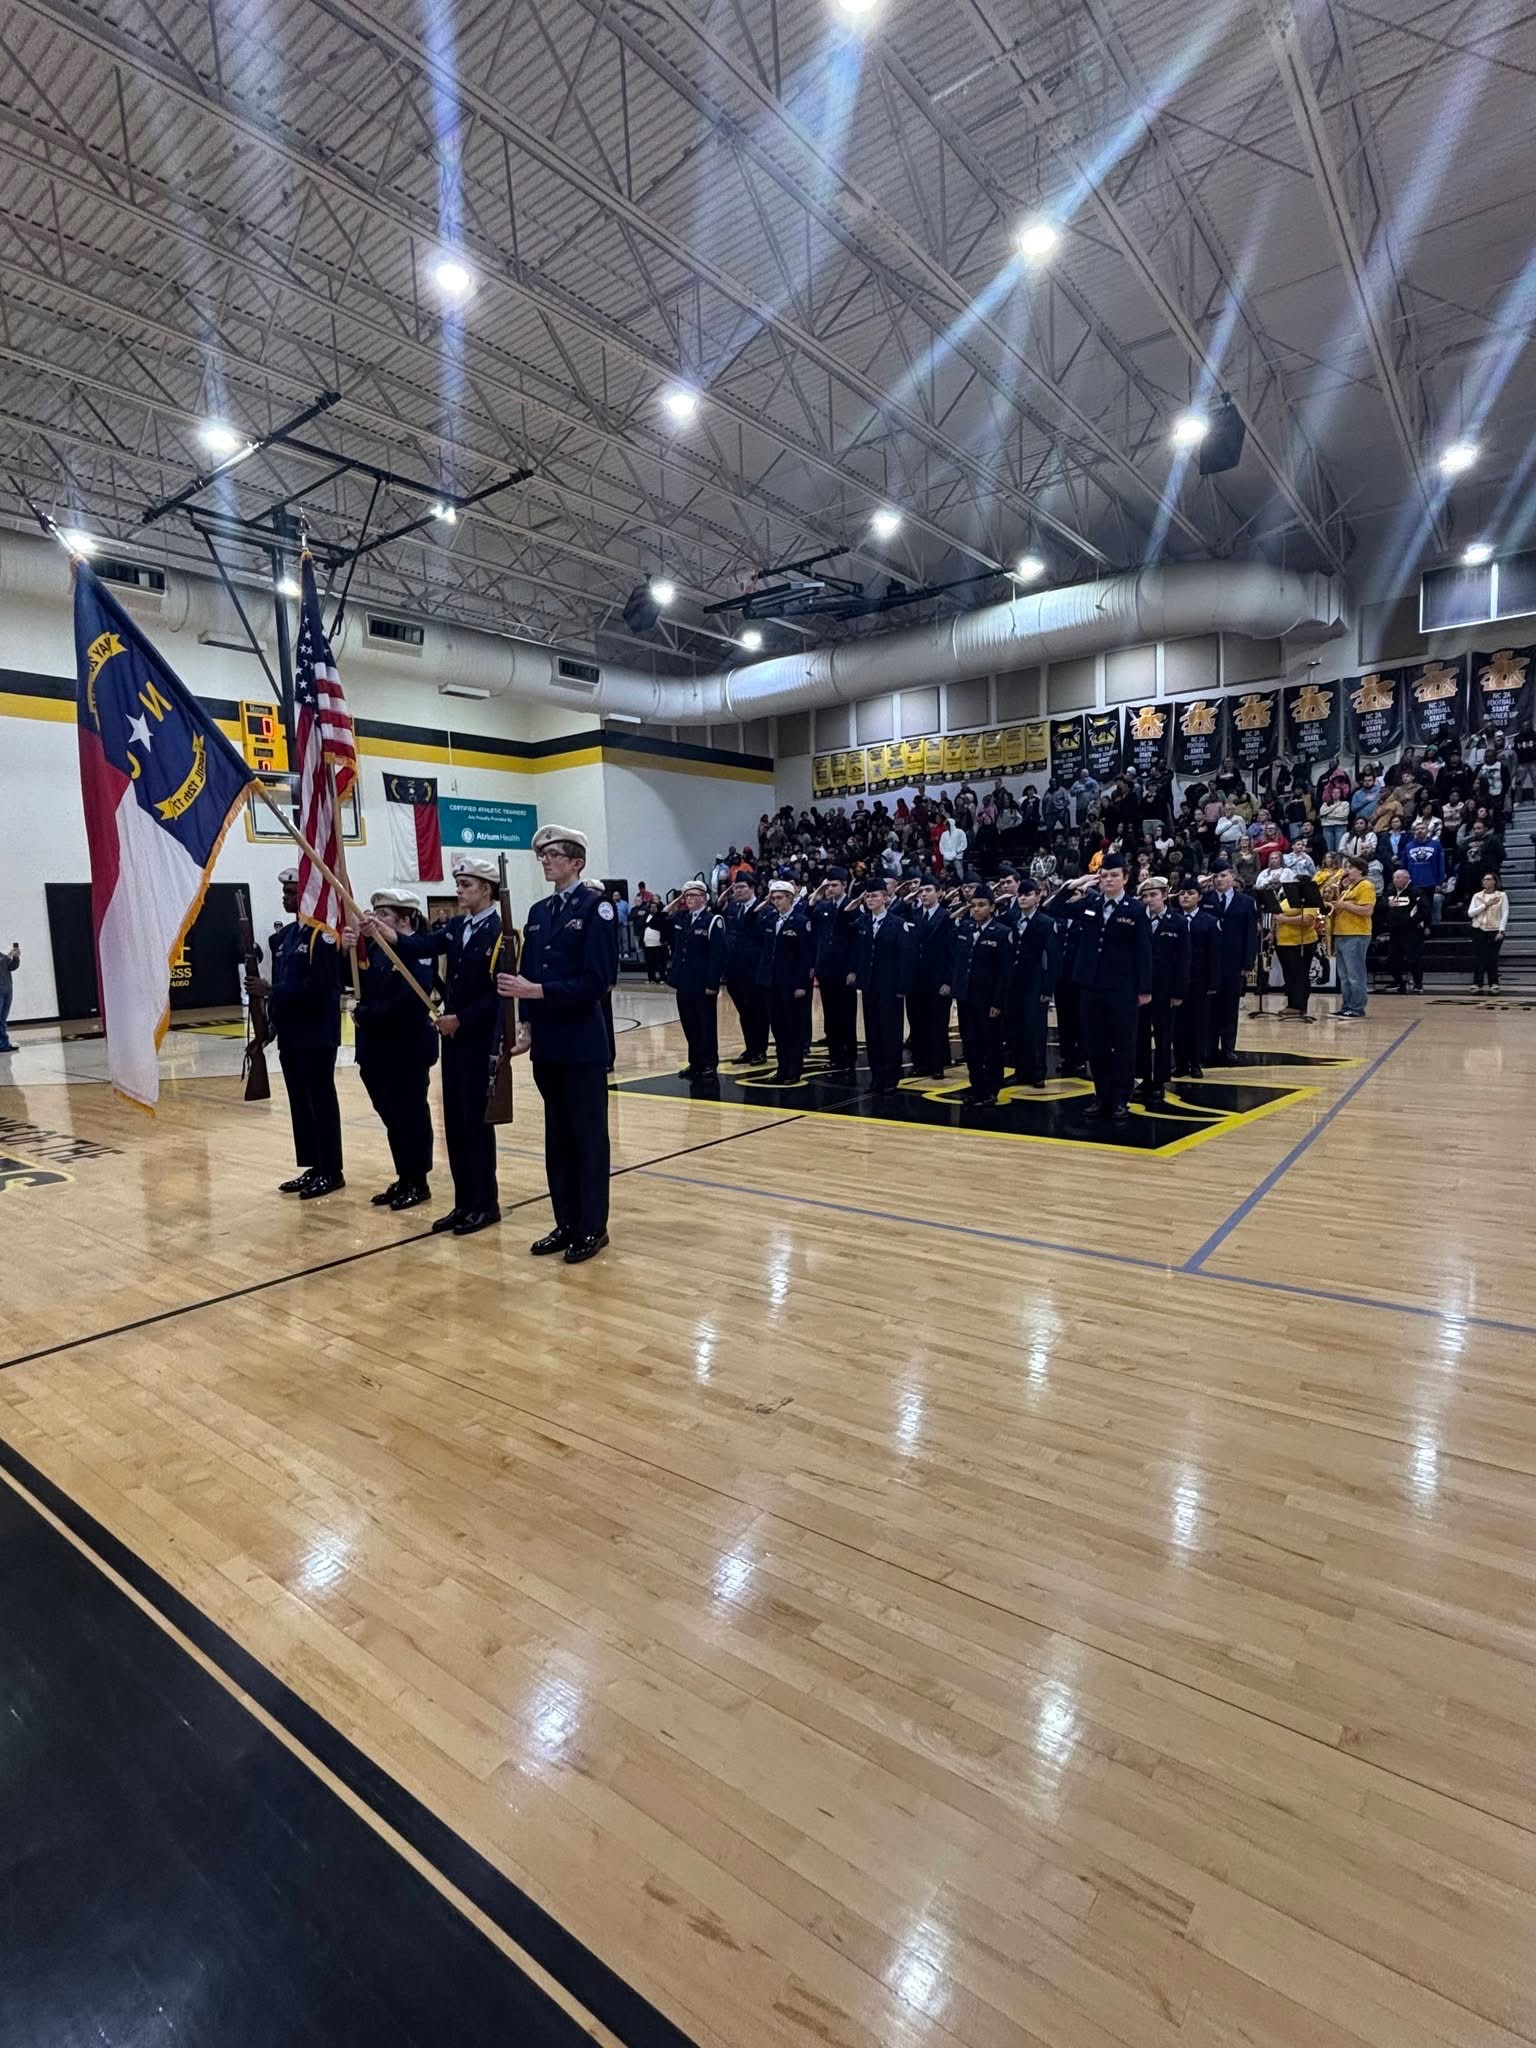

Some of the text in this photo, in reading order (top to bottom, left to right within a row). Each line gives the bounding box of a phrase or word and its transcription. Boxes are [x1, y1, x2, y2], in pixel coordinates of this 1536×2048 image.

[1487, 698, 1515, 706] FOOTBALL
[1424, 707, 1451, 716] FOOTBALL
[1491, 705, 1510, 713] STATE
[1361, 718, 1387, 727] FOOTBALL
[1429, 714, 1447, 722] STATE
[262, 717, 273, 736] 0
[1365, 725, 1382, 733] STATE
[1359, 729, 1390, 740] RUNNER UP
[449, 804, 477, 812] CERTIFIED
[503, 808, 527, 816] TRAINERS
[476, 832, 521, 842] Atrium Health
